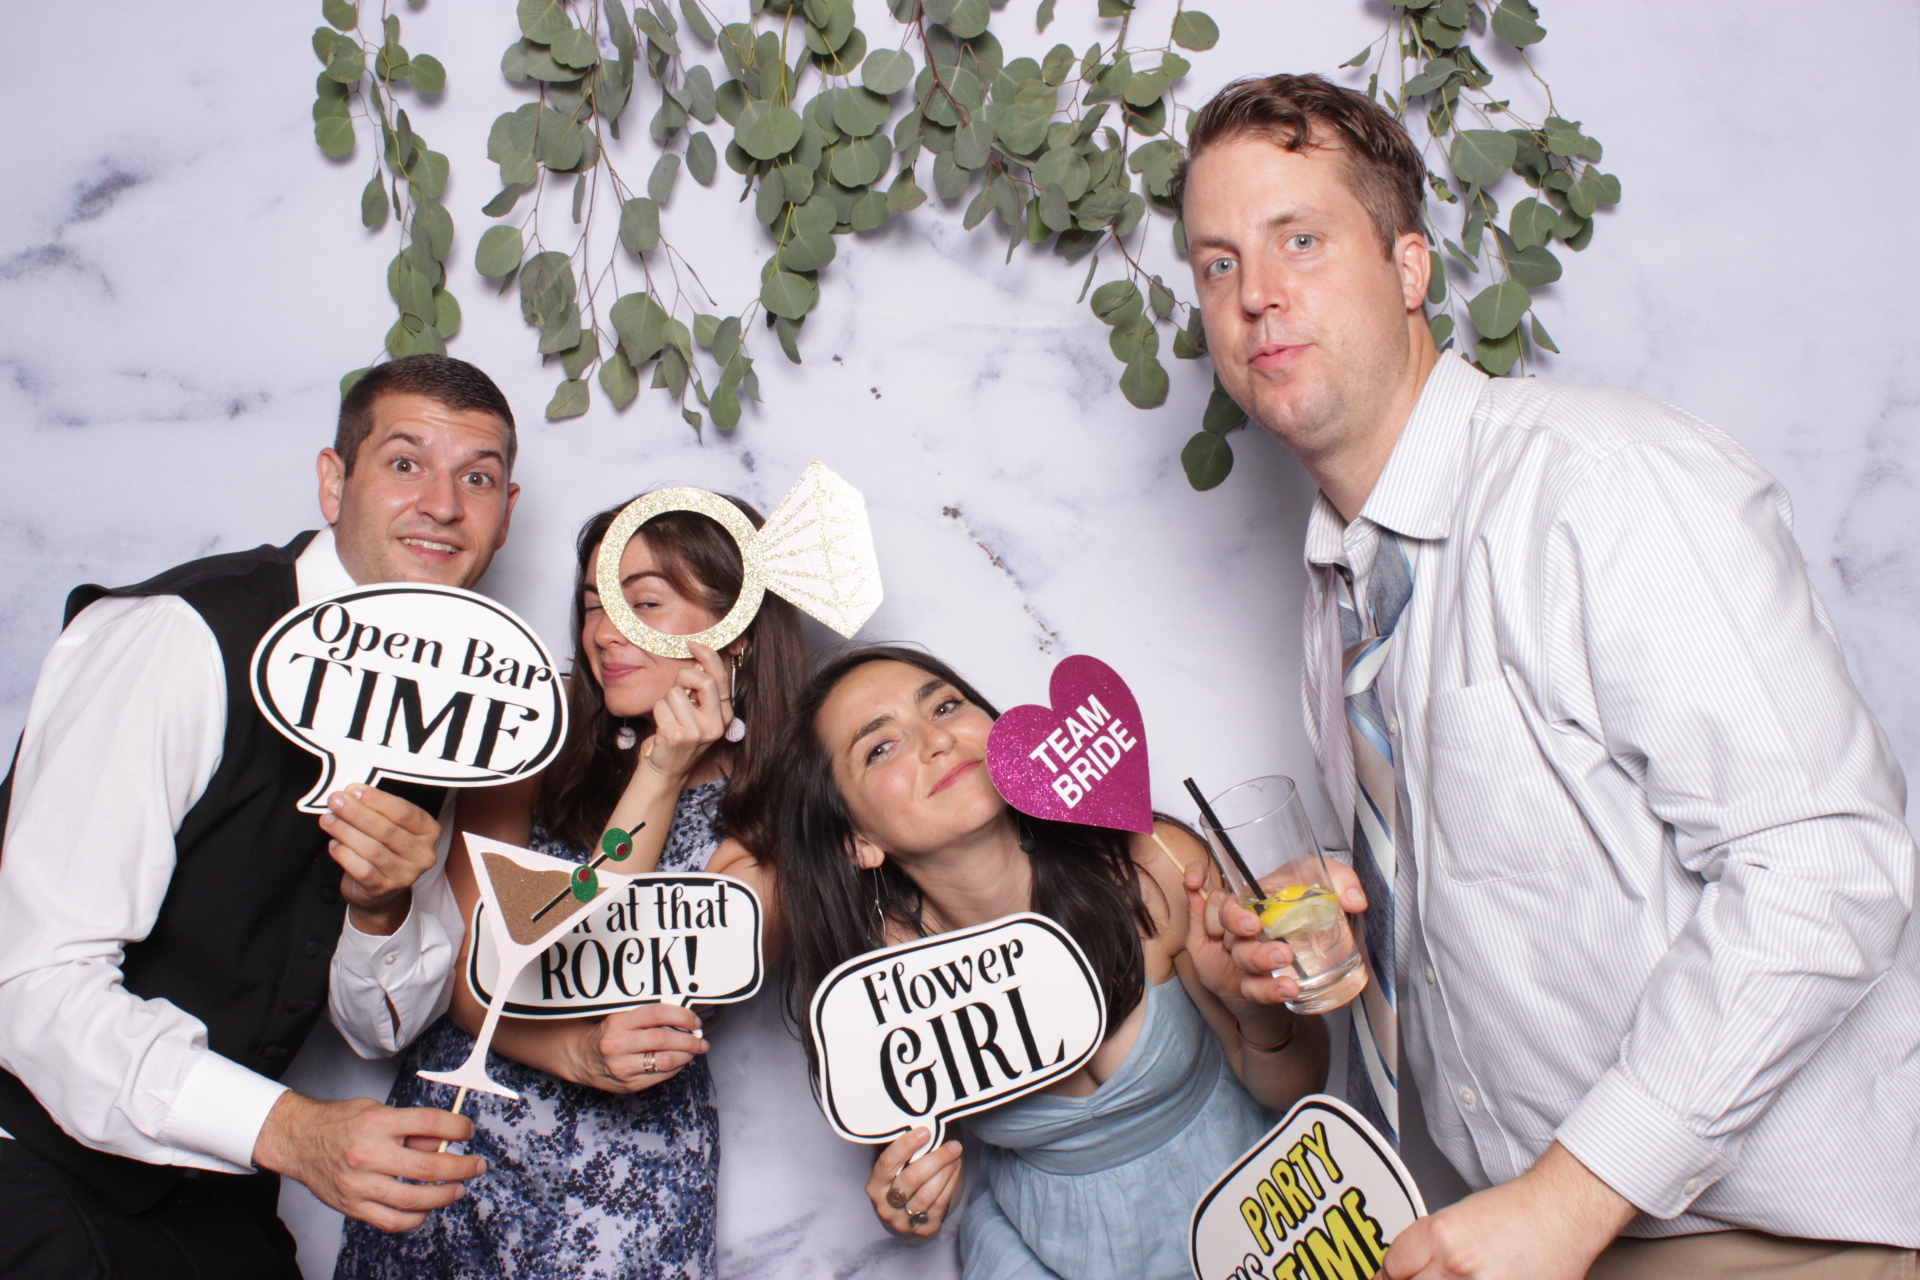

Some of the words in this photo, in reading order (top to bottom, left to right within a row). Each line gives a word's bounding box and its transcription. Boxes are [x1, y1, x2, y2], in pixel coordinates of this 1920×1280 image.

[312, 604, 443, 668] Open
[460, 637, 553, 690] Bar
[289, 652, 540, 775] TIME
[1028, 694, 1112, 774] TEAM
[1051, 718, 1137, 809] BRIDE
[606, 886, 640, 933] at
[654, 883, 729, 931] that
[540, 935, 699, 1000] ROCK!
[860, 938, 1024, 1026] Flower
[879, 985, 1066, 1117] GIRL
[1239, 1121, 1344, 1257] PARTY
